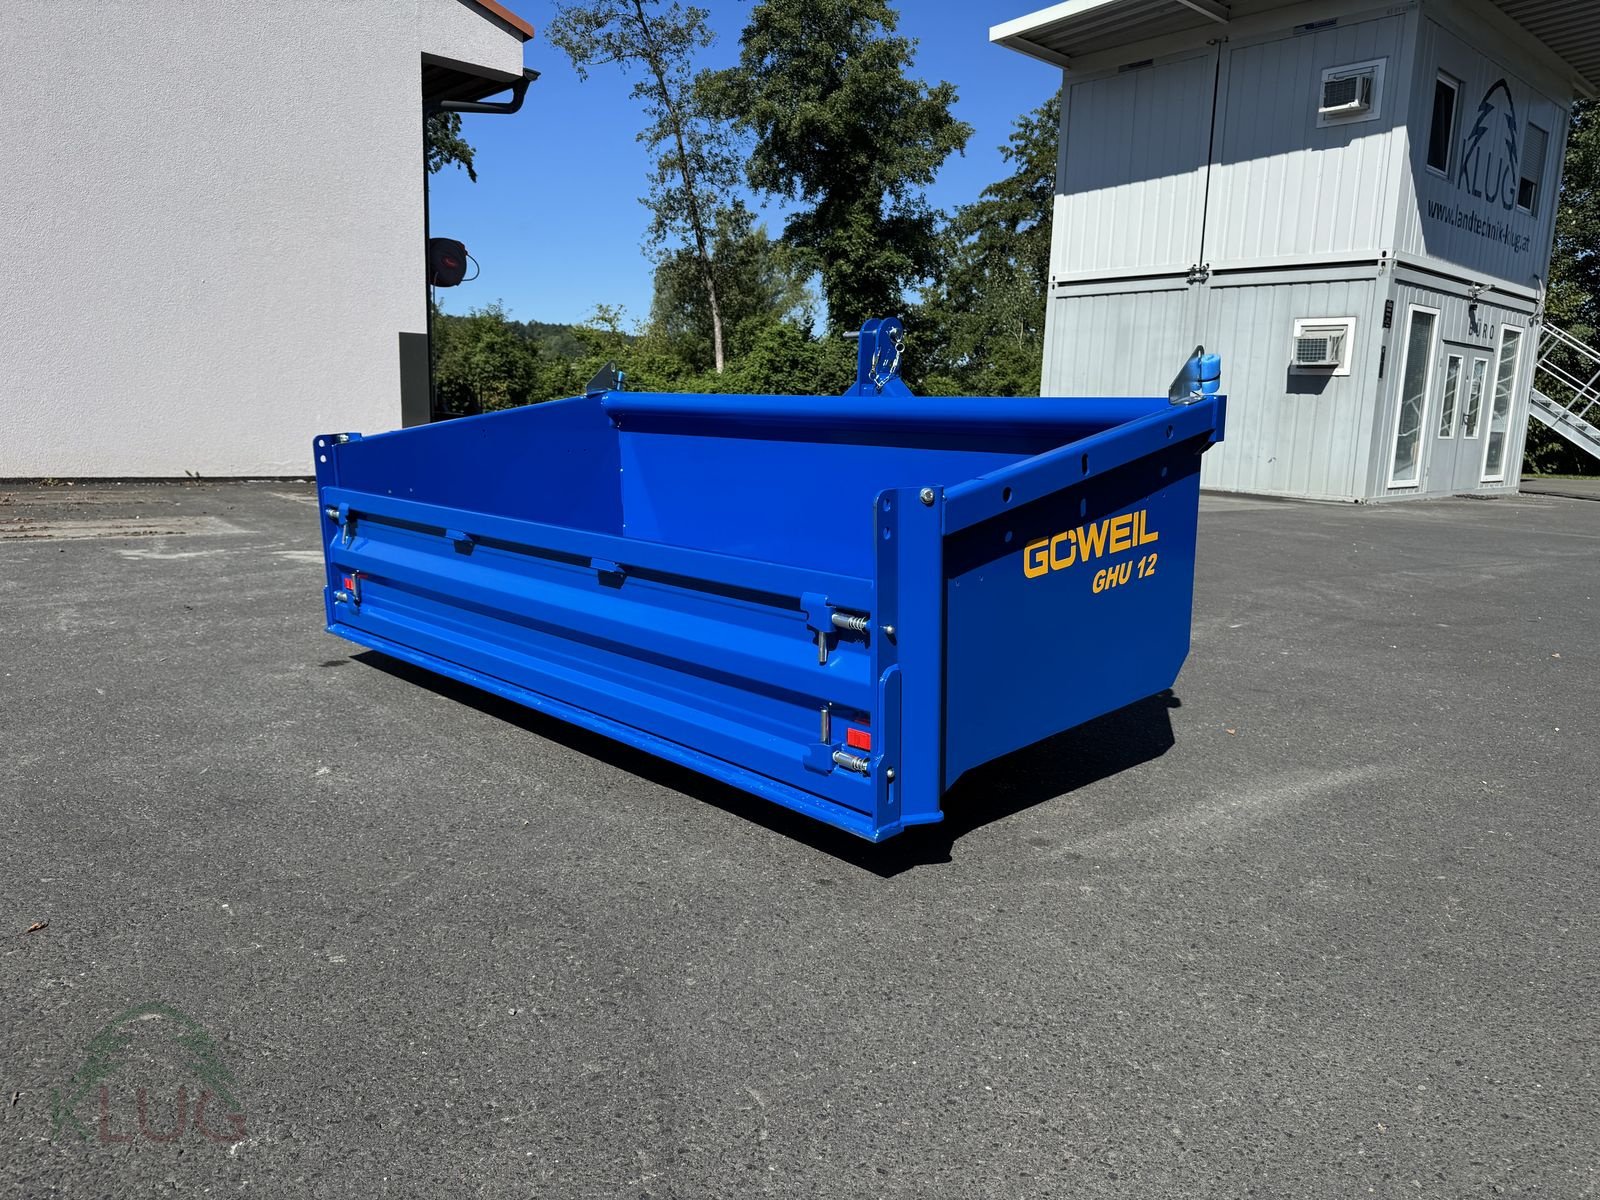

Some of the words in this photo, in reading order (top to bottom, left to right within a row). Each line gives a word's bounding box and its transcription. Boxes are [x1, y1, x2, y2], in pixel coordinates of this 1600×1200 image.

[1457, 138, 1517, 211] KLUG
[1427, 199, 1531, 253] www.landtechnik-klug.at
[1092, 560, 1133, 594] GHU
[1137, 553, 1158, 579] 12
